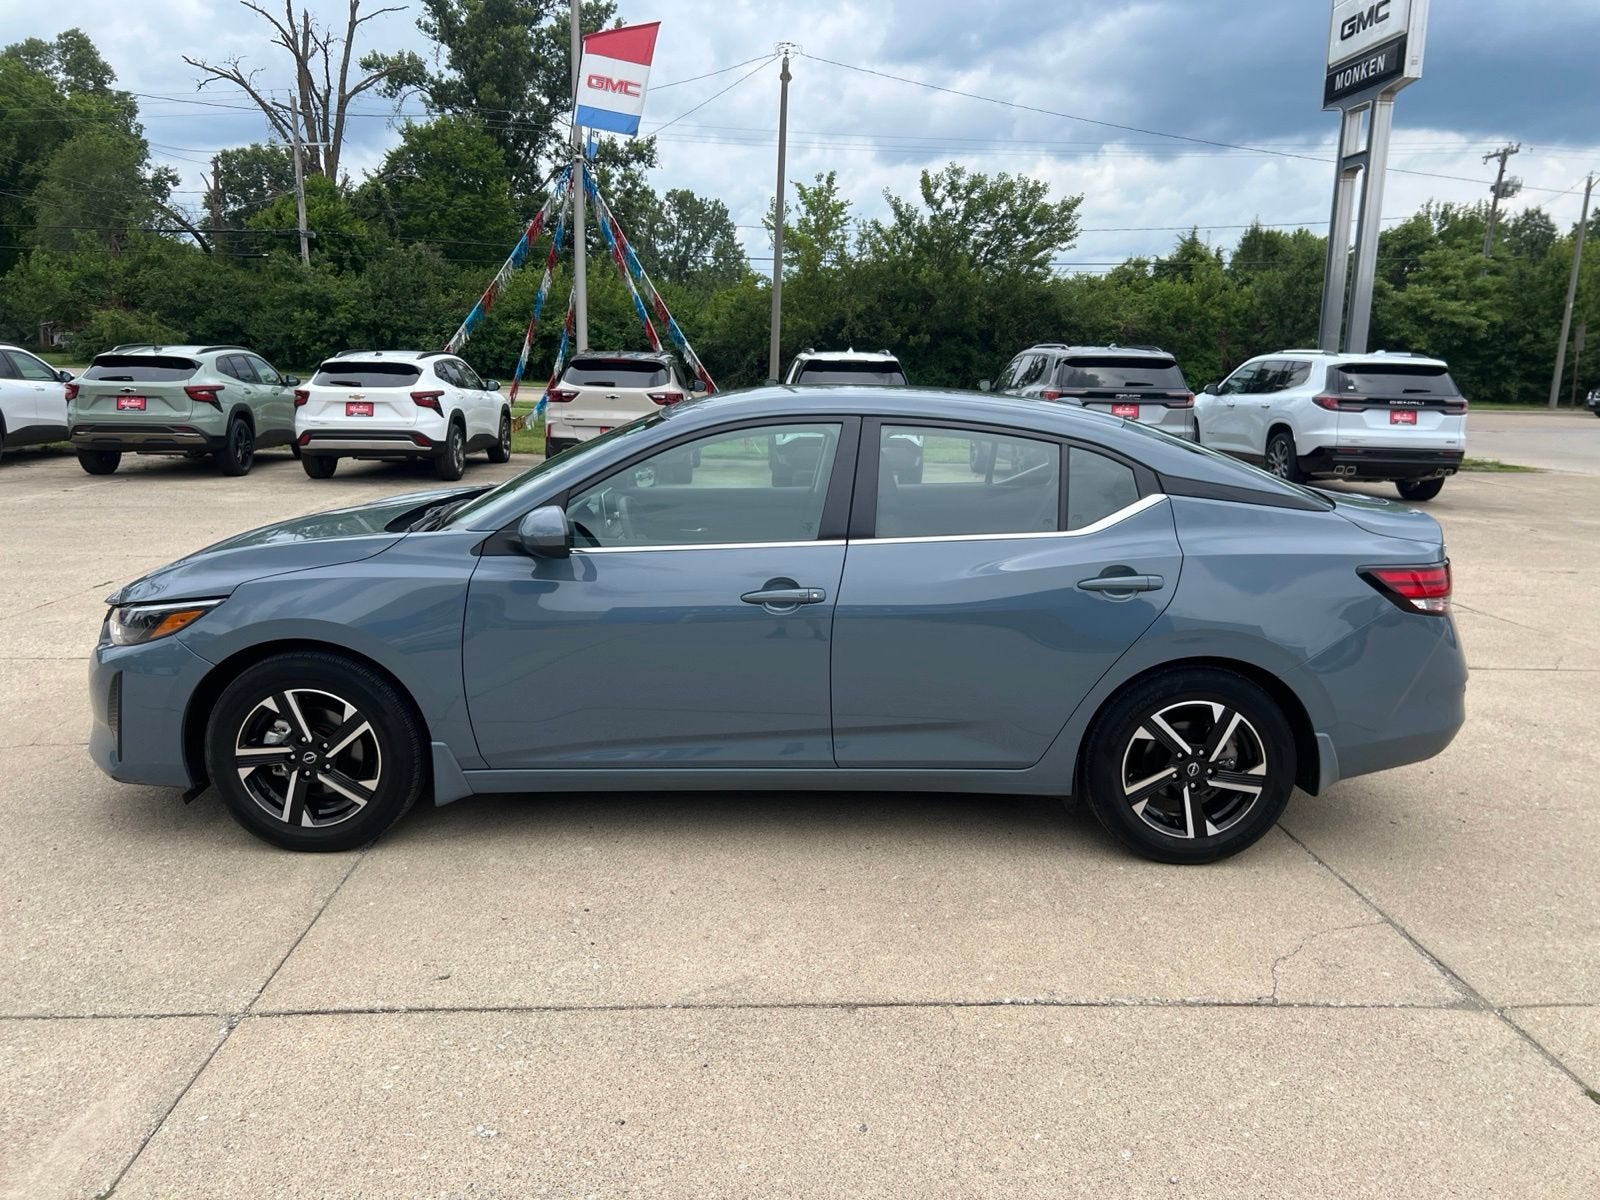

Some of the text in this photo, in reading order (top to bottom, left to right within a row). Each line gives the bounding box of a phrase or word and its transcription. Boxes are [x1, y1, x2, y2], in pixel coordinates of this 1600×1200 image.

[1340, 0, 1391, 40] GMC
[588, 75, 641, 97] GMC
[1335, 54, 1386, 90] MONKEN
